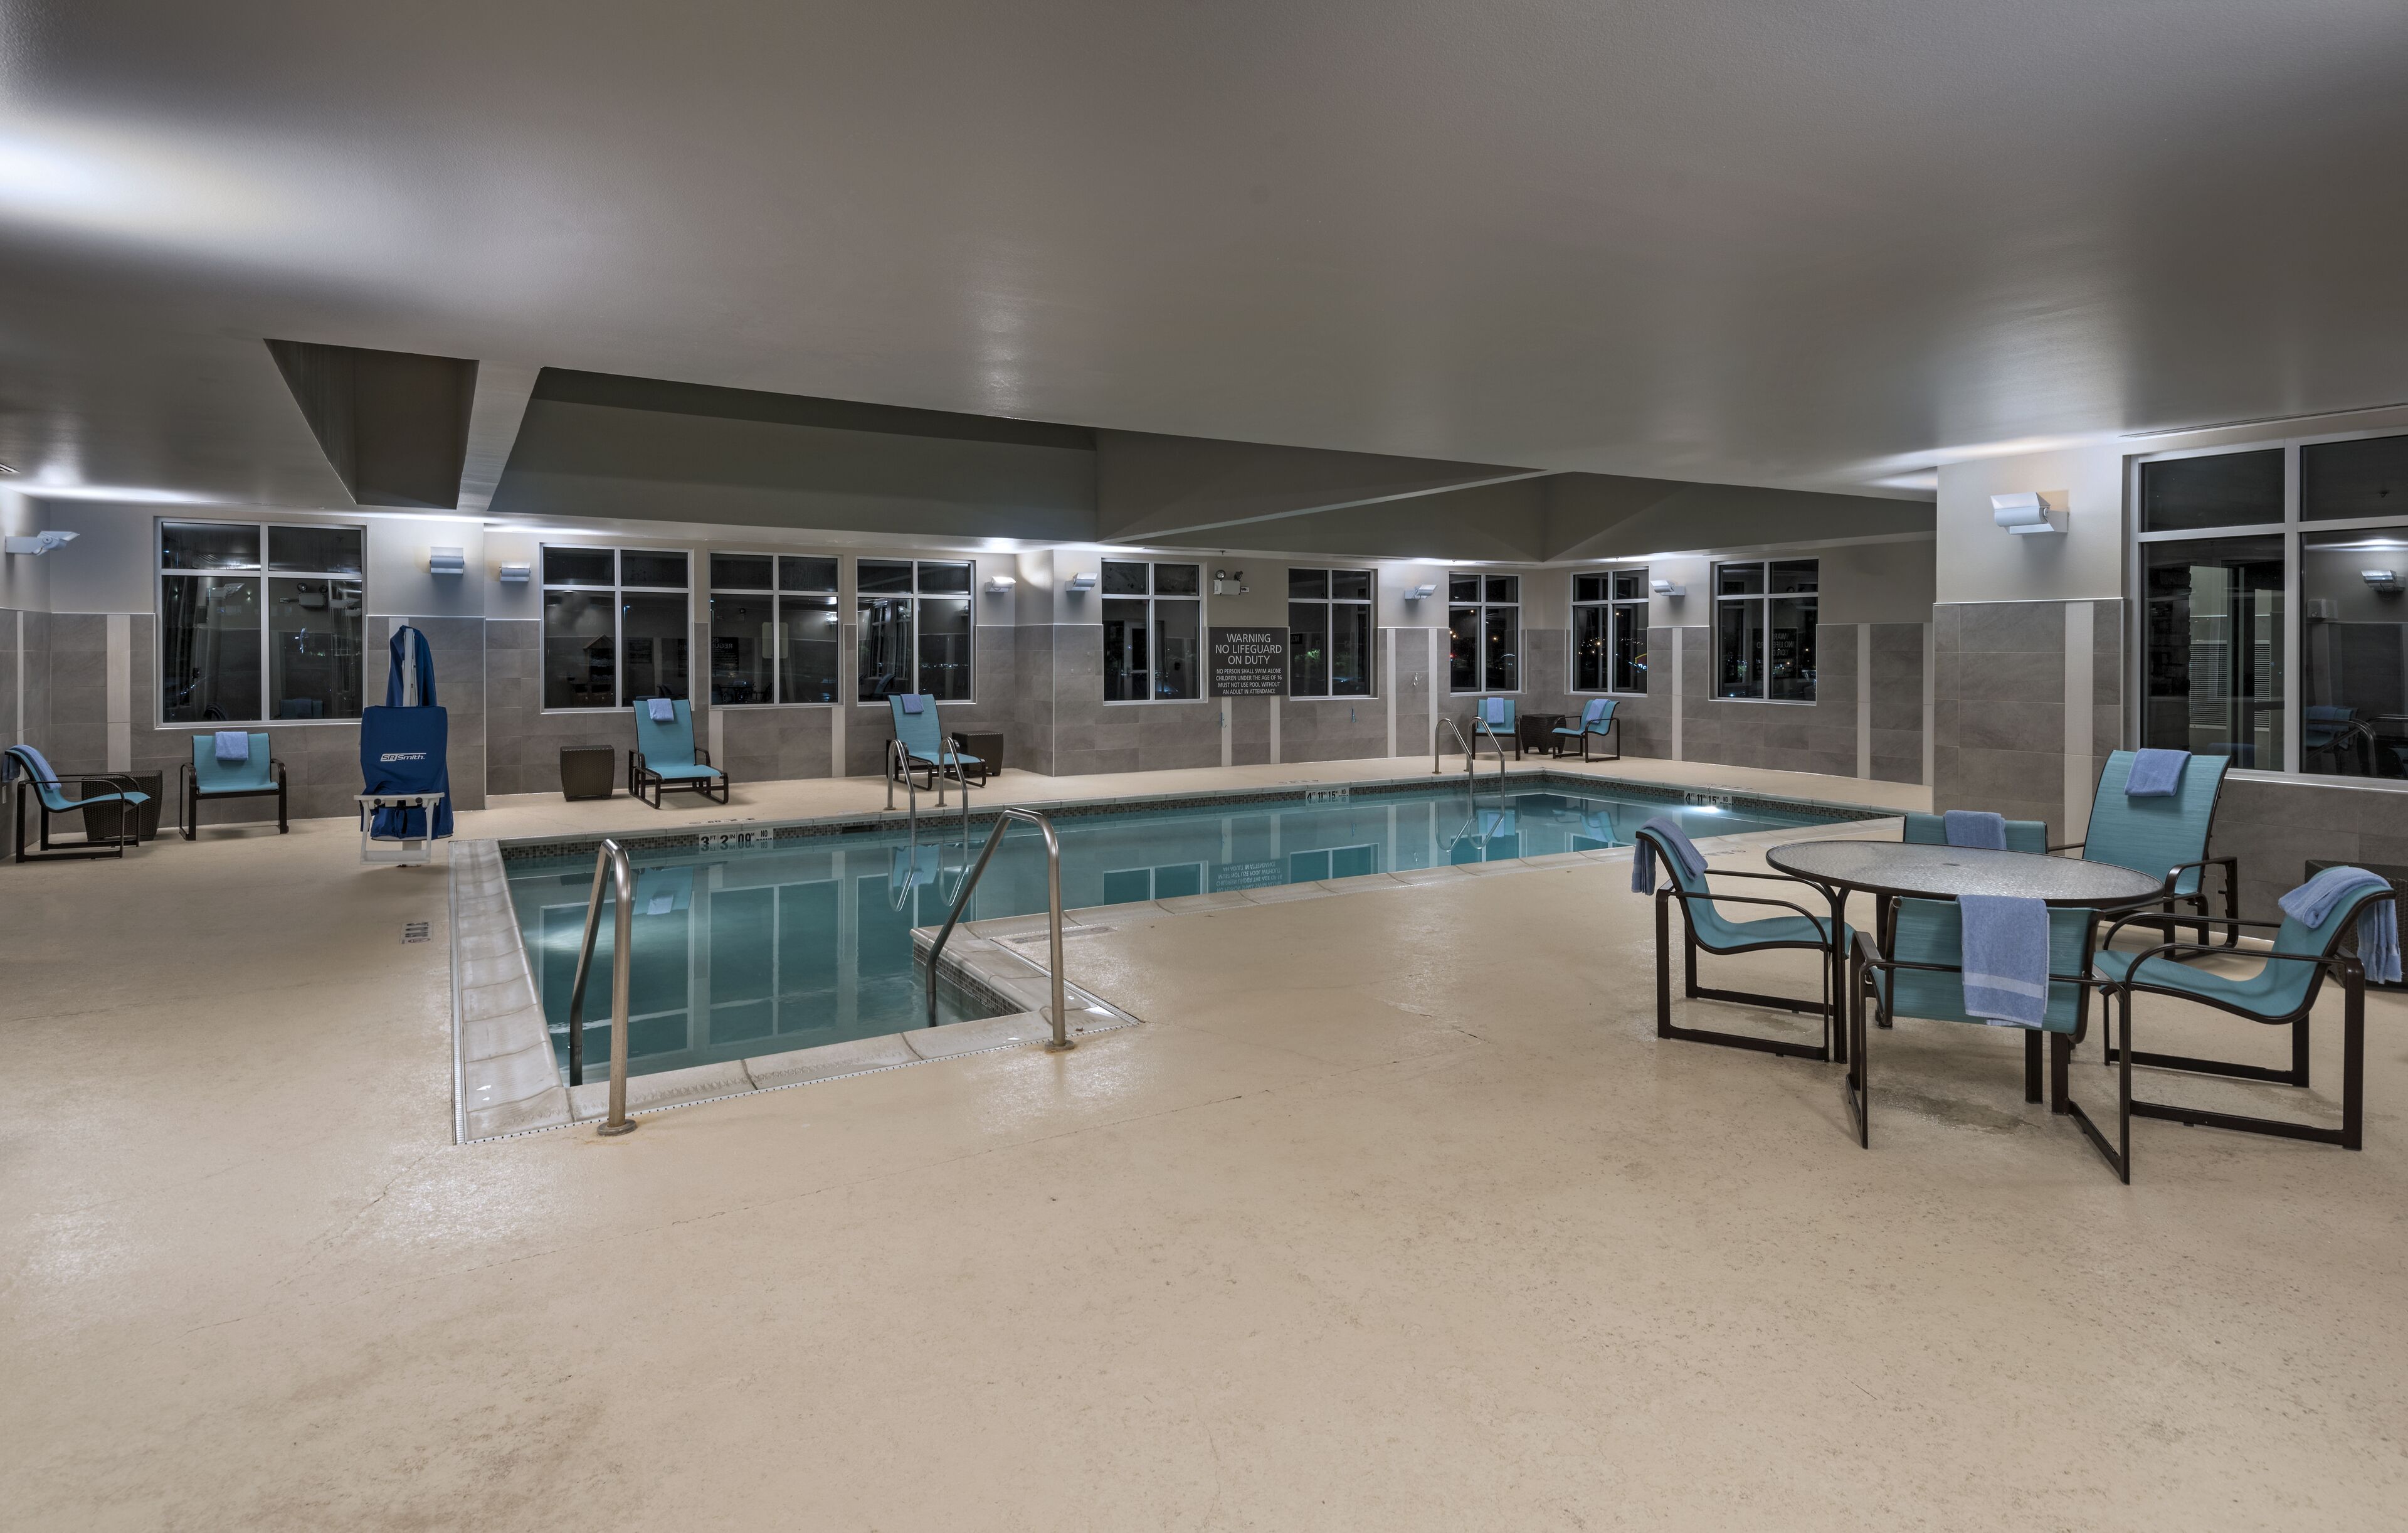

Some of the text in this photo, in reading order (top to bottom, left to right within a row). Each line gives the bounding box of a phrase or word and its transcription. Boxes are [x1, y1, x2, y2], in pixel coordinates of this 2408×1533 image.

[1227, 634, 1270, 643] WARNING
[1215, 645, 1282, 654] NO LIFEGUARD
[1228, 655, 1270, 664] ON DUTY
